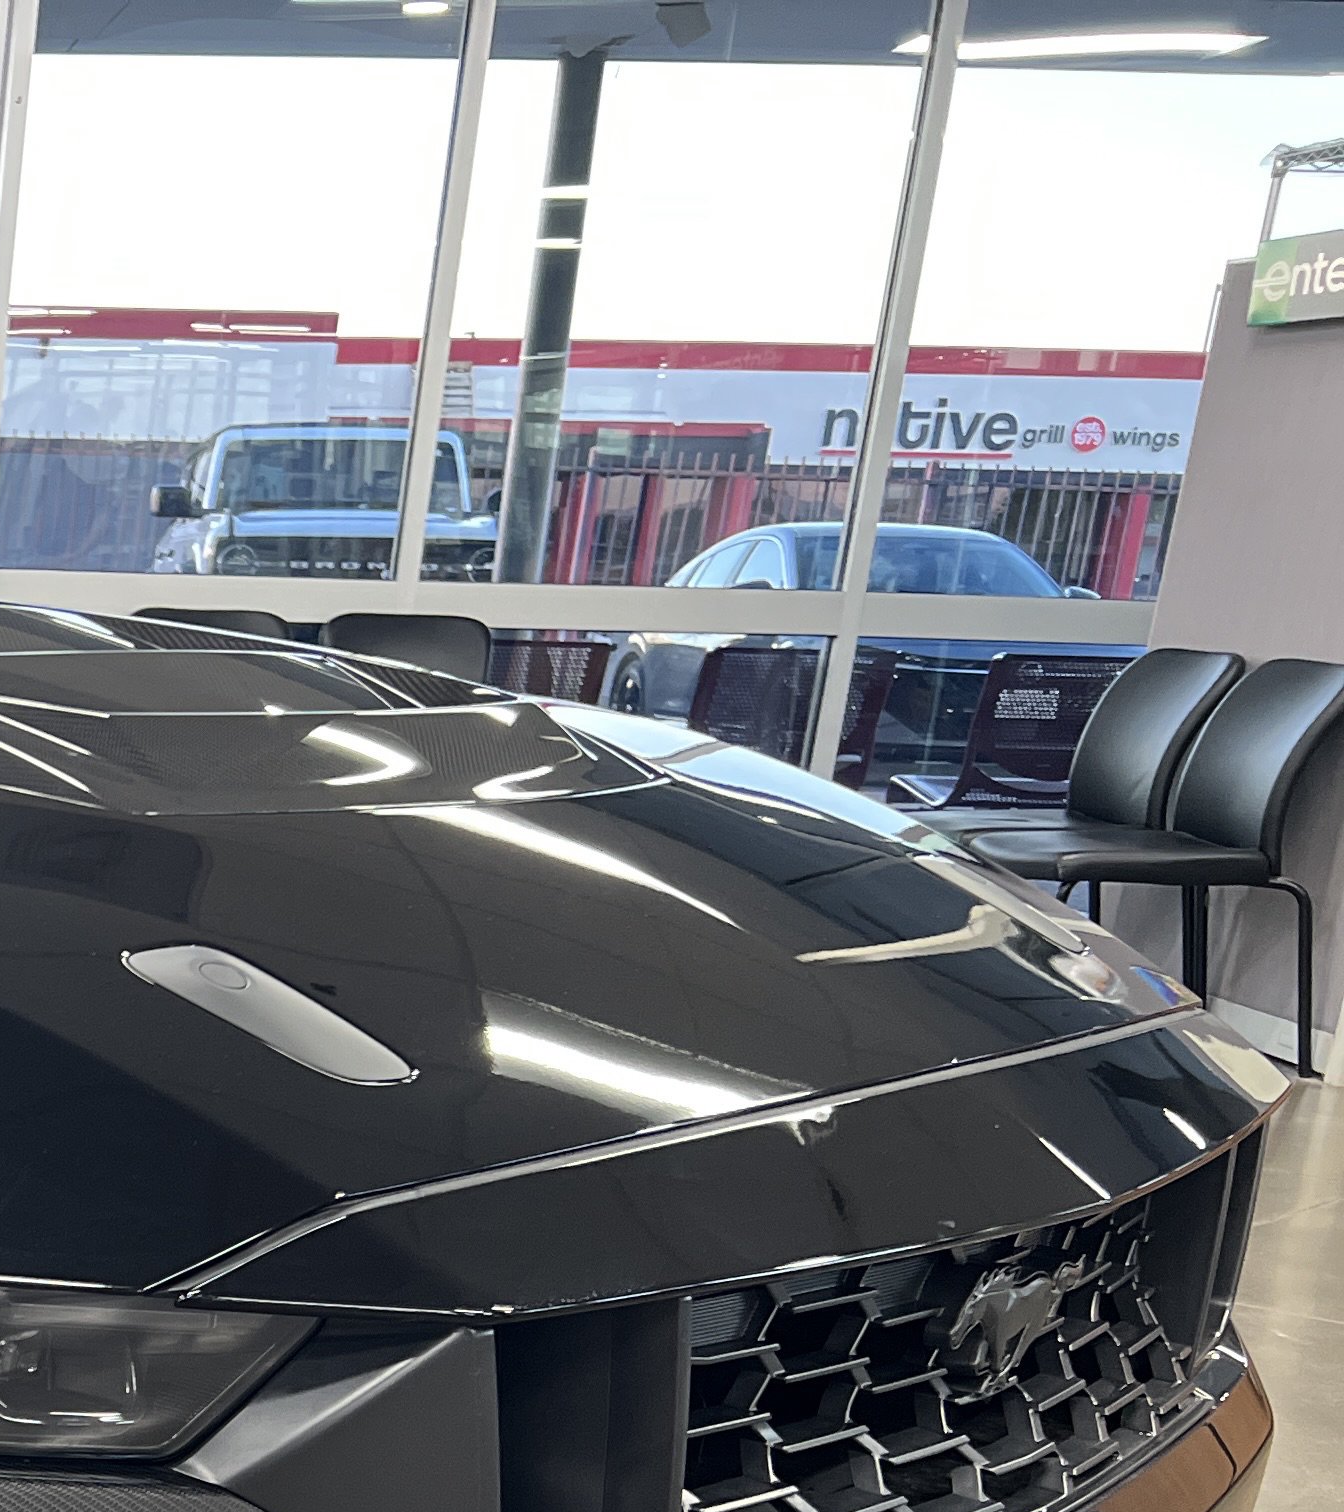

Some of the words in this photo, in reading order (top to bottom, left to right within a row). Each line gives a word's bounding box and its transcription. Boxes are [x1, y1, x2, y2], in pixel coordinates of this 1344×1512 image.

[822, 397, 1018, 451] ntive
[1022, 424, 1065, 448] grill
[1112, 427, 1180, 451] wings
